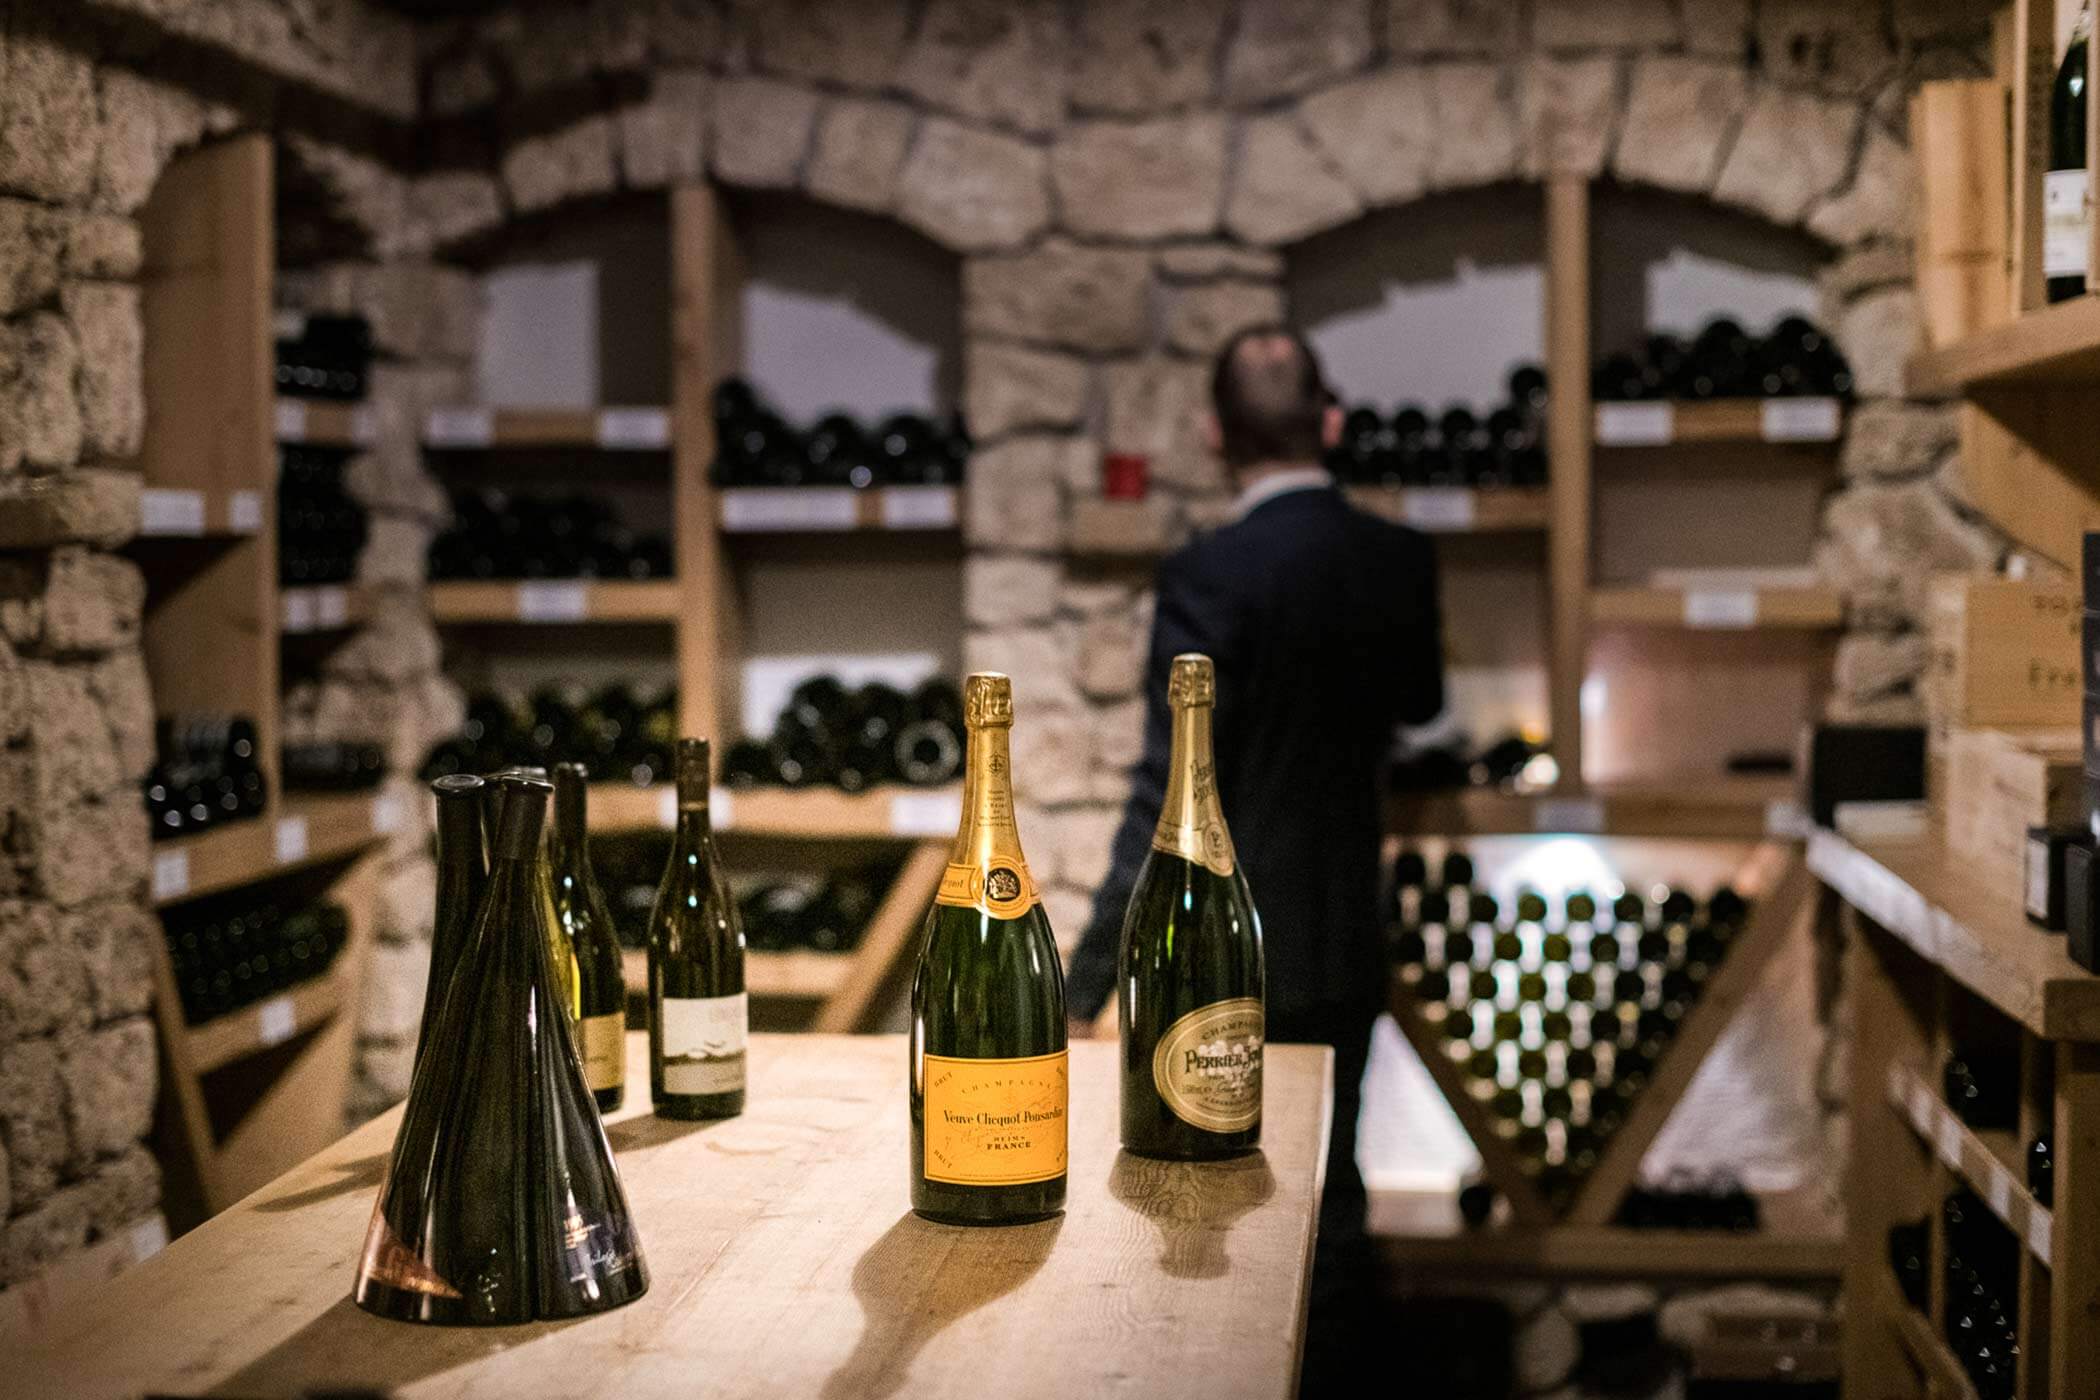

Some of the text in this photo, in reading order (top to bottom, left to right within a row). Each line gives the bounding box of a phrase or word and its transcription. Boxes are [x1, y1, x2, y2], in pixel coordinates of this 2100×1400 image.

[943, 1109, 974, 1125] Veuve
[976, 1112, 1021, 1126] Clicquot
[986, 1141, 1032, 1151] FRANCE
